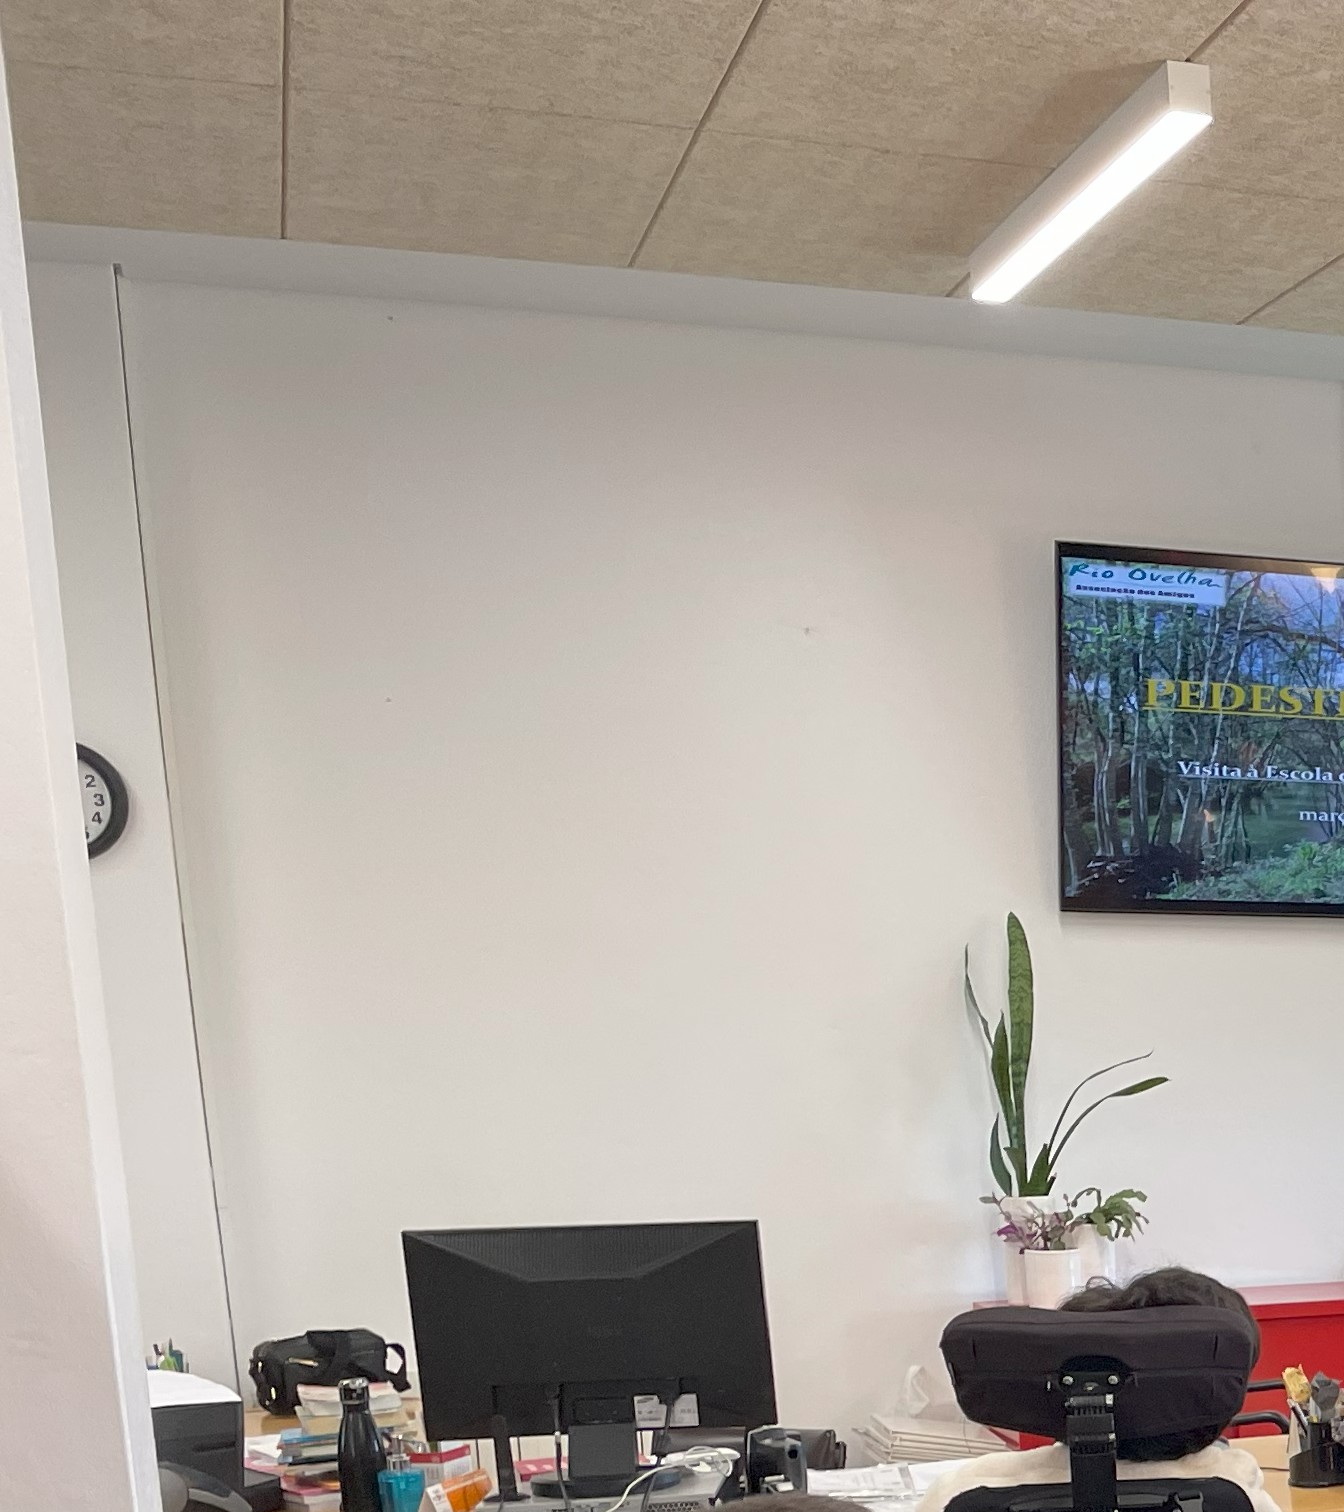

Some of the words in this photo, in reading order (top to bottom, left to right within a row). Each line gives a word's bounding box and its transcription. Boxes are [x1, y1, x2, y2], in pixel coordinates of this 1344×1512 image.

[1069, 562, 1114, 578] Rio
[1128, 567, 1222, 589] Ovelha
[1177, 760, 1242, 778] Visita
[1265, 764, 1332, 781] Escola
